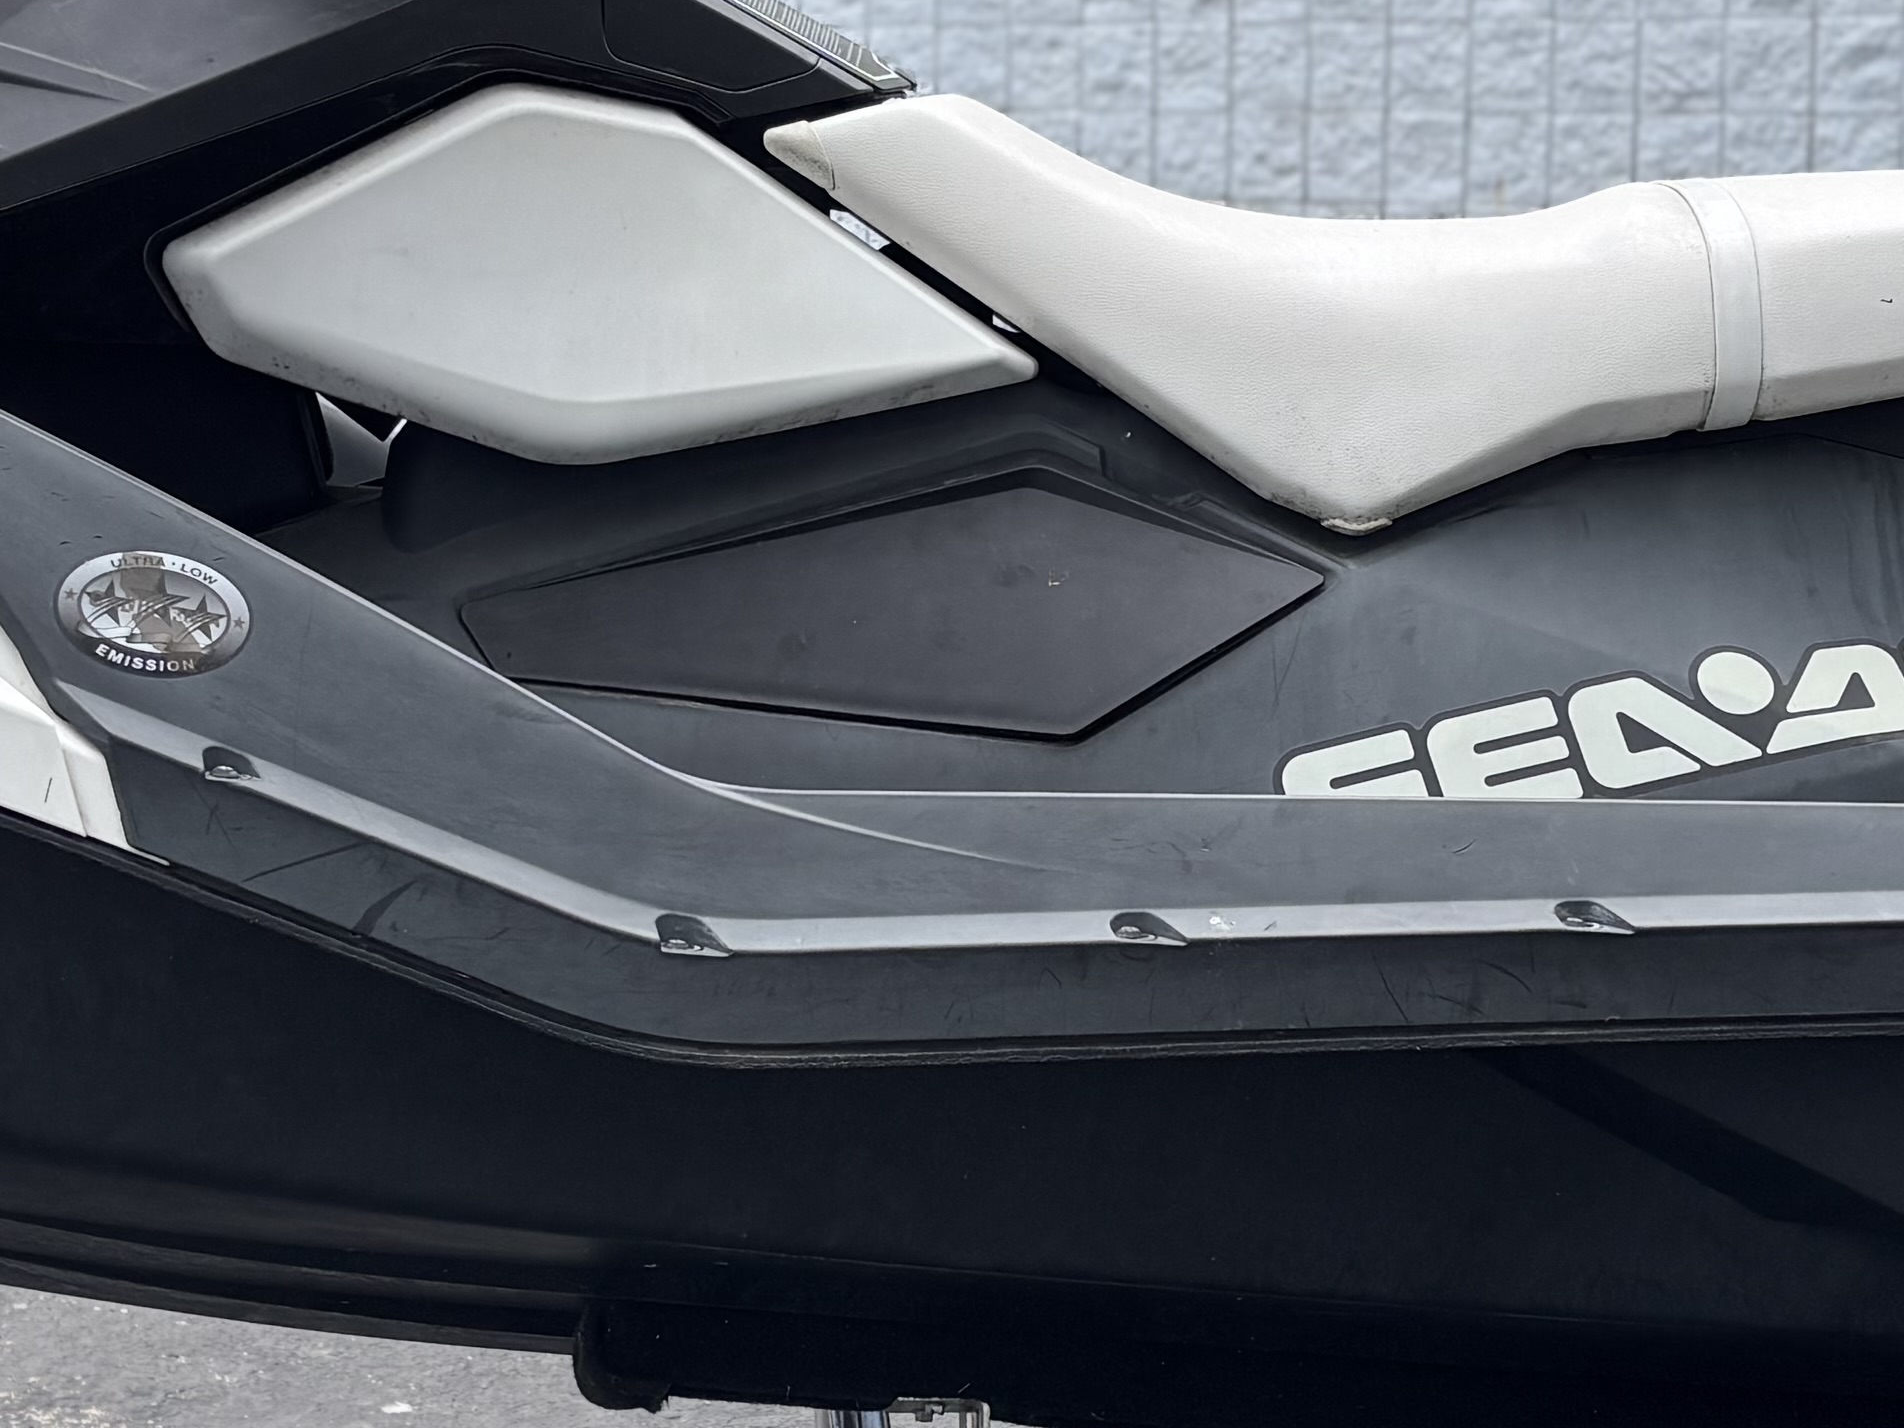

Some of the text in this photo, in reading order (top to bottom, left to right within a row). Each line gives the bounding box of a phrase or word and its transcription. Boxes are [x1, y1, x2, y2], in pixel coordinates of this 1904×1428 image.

[110, 555, 219, 585] ULTRA LOW
[95, 642, 196, 673] EMISSION
